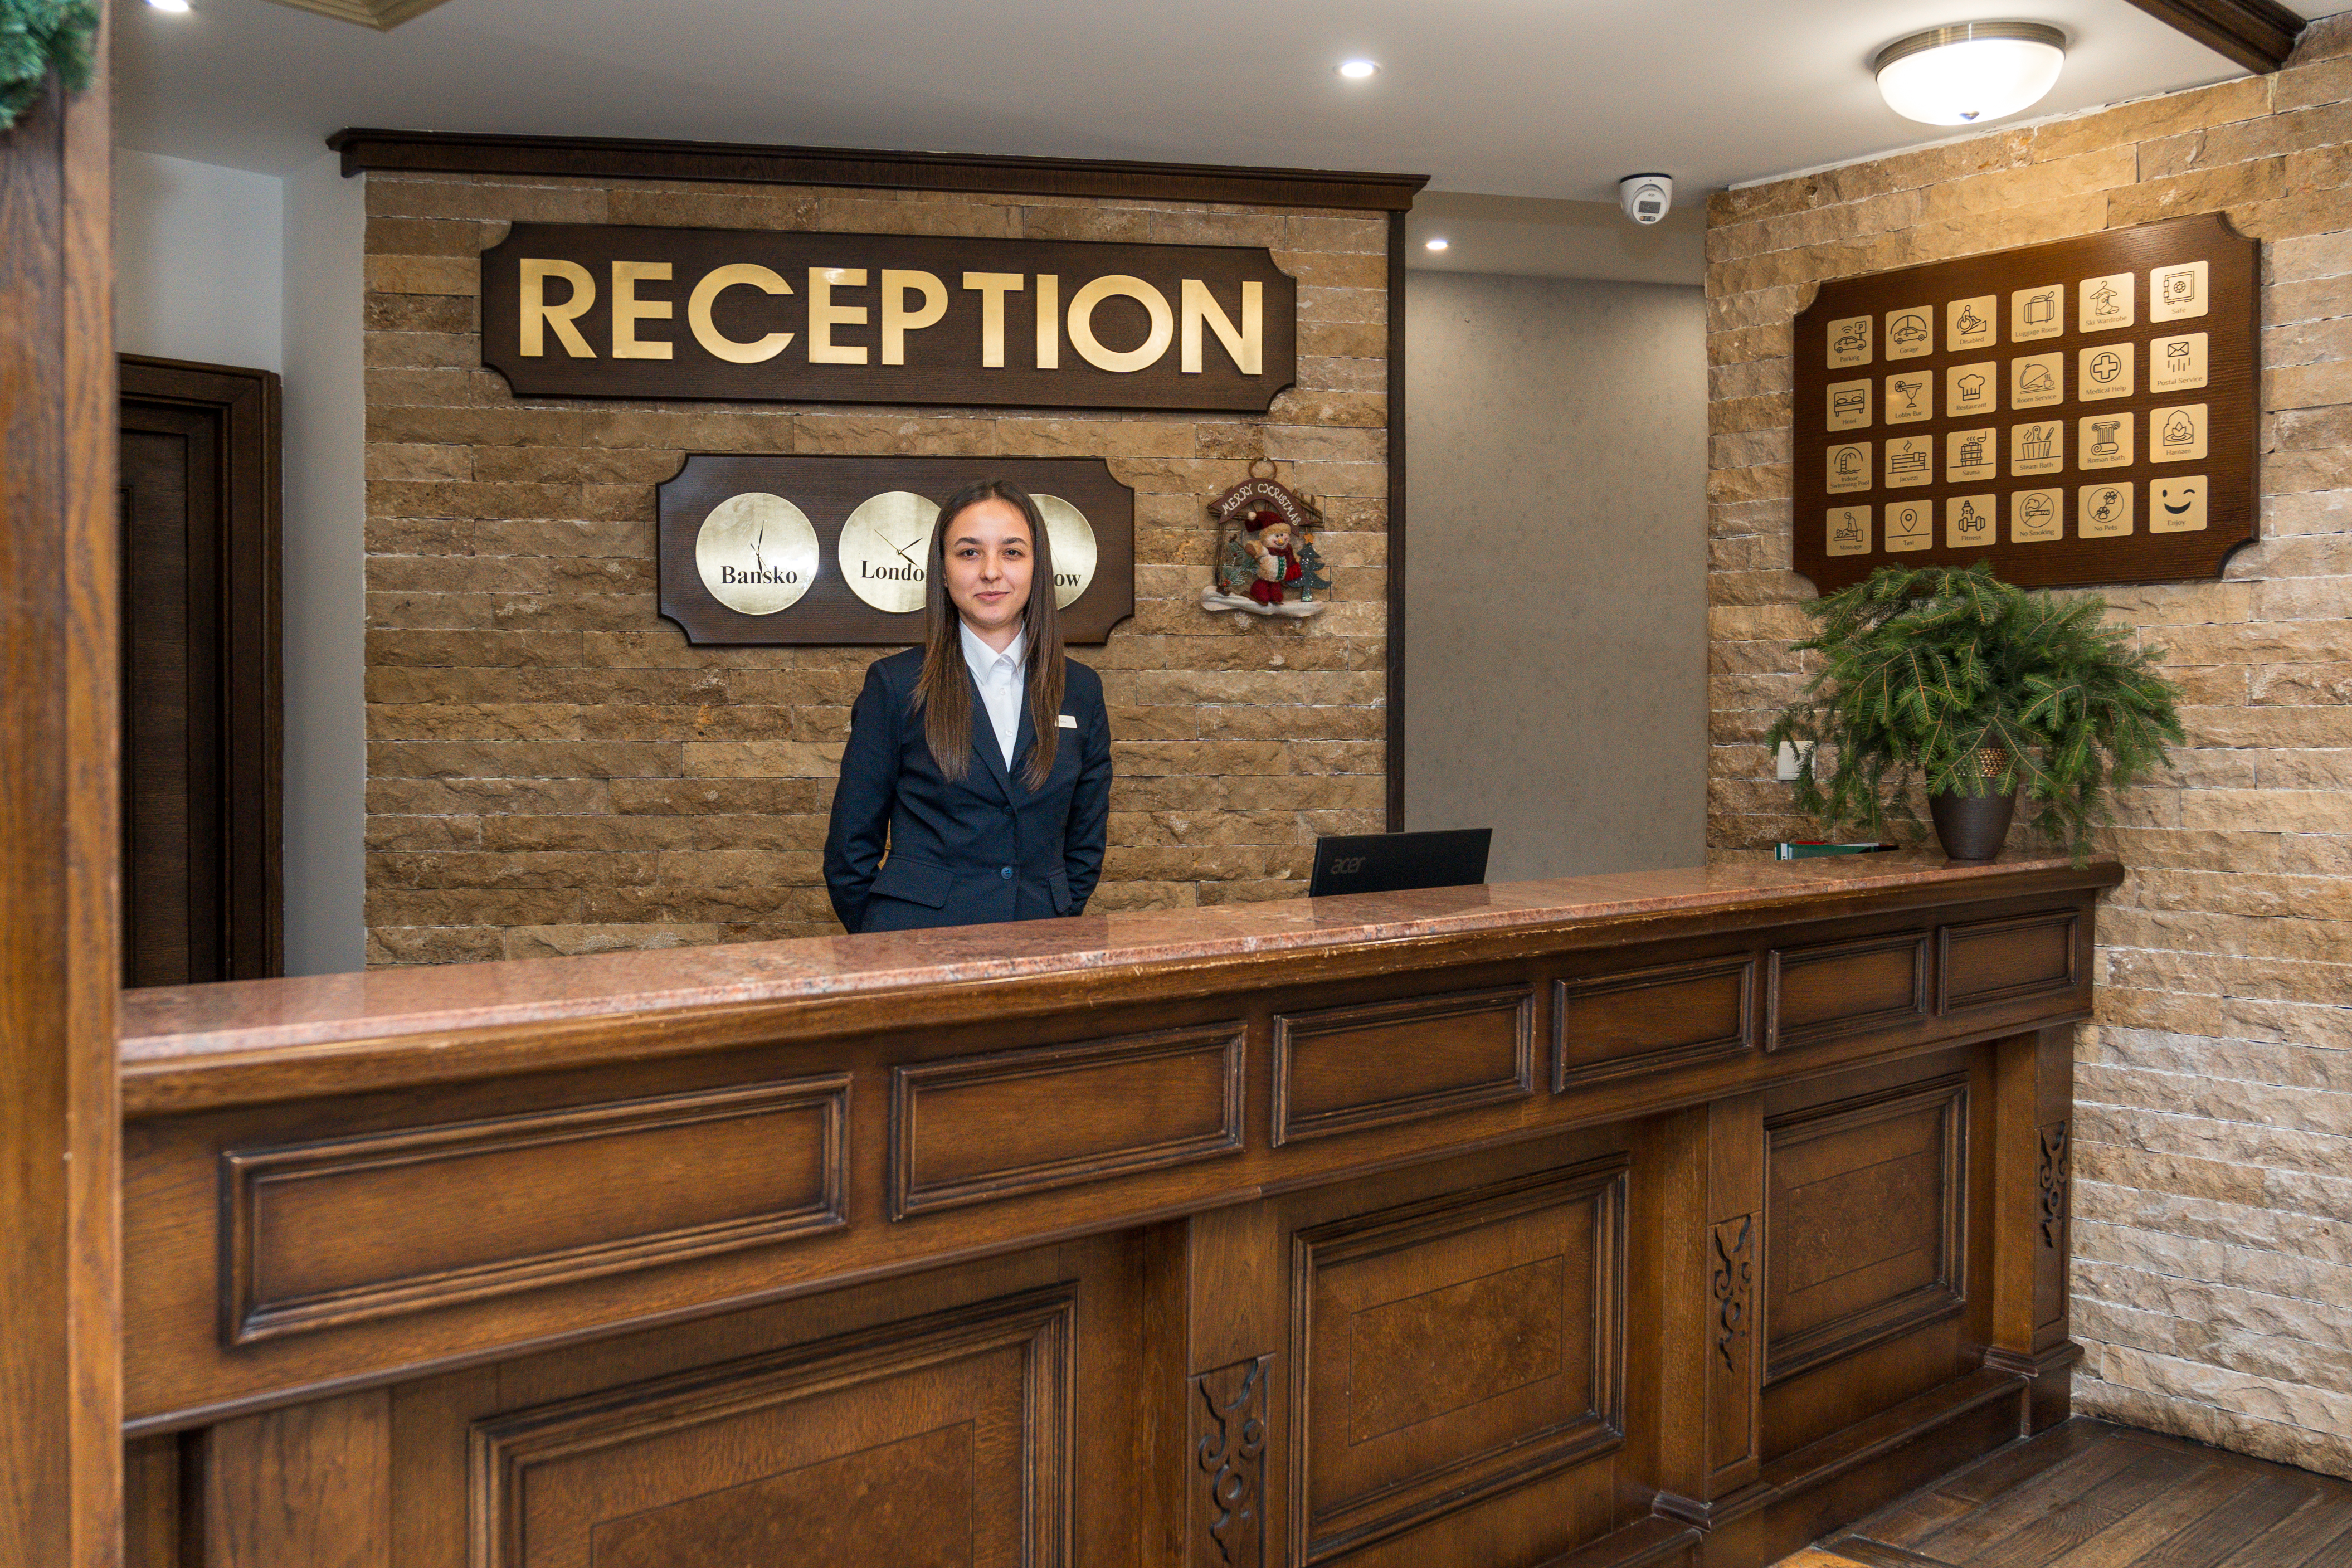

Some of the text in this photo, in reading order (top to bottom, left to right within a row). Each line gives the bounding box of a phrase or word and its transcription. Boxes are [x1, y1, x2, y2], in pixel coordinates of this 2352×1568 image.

[519, 258, 1263, 375] RECEPTION
[2097, 316, 2127, 324] Wardrobe
[1221, 483, 1301, 526] MERRY CHRISTMAS
[720, 566, 798, 585] Bansko
[860, 559, 925, 582] Londo
[1331, 857, 1365, 874] acer
